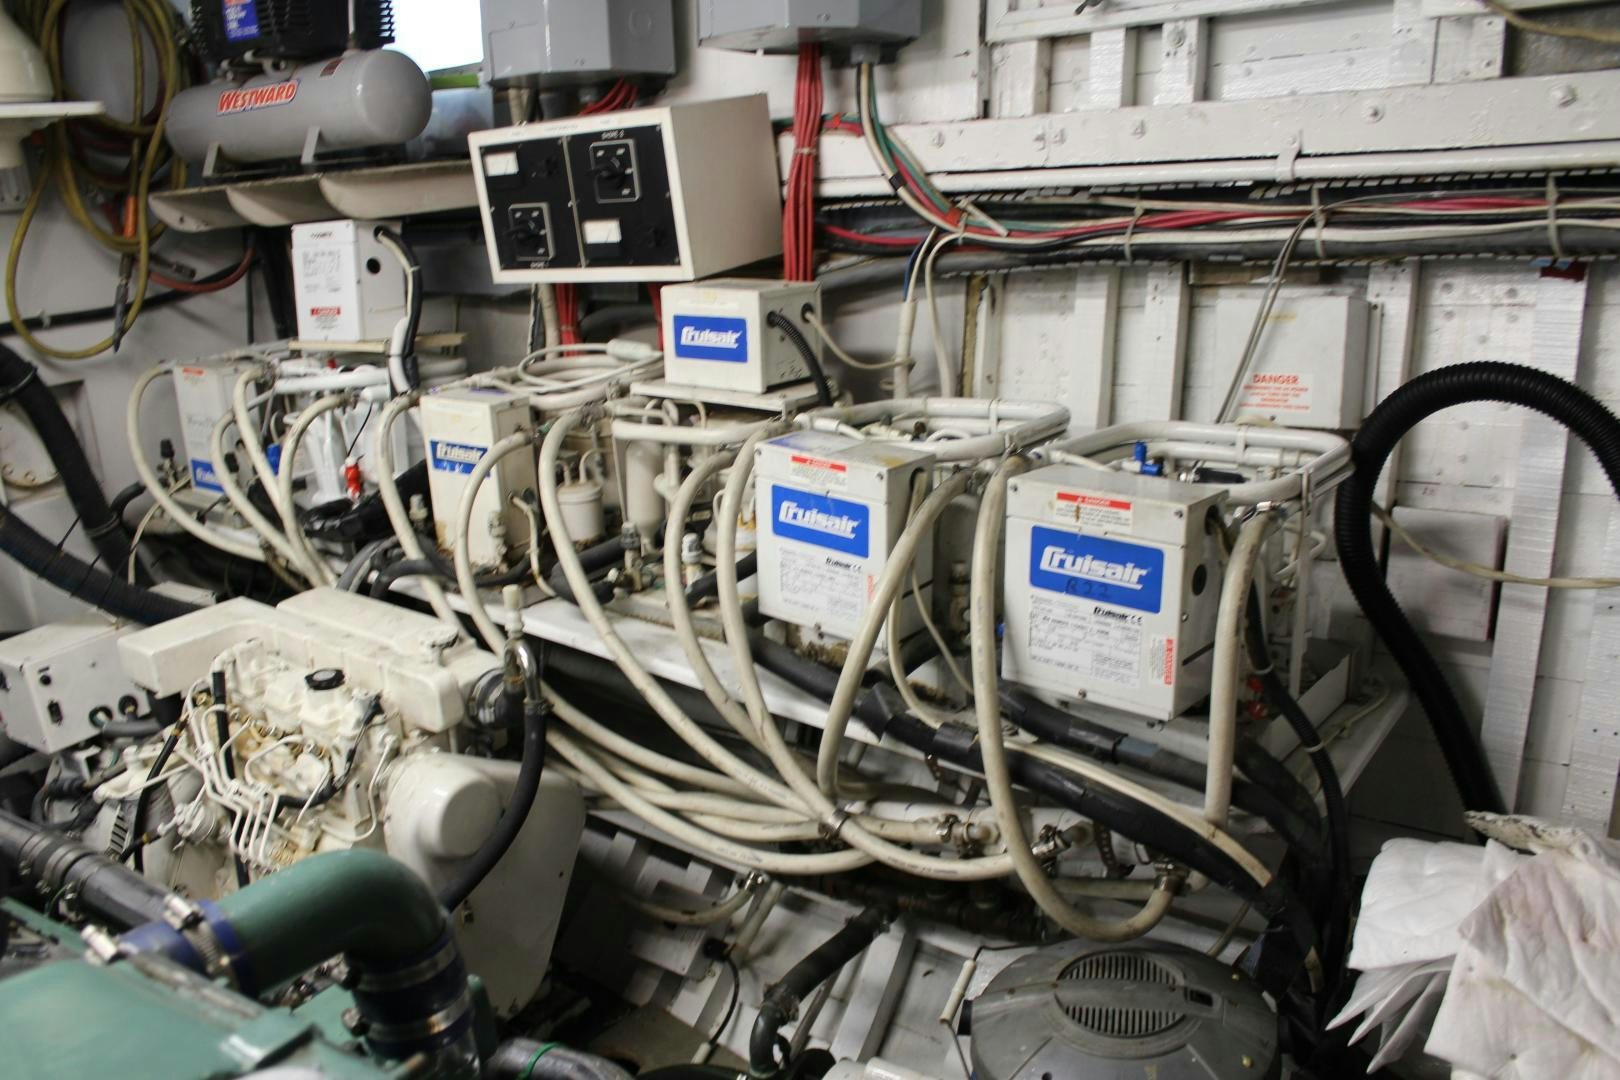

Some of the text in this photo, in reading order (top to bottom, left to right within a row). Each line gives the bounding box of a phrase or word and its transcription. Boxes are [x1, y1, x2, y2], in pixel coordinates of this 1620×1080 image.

[219, 82, 297, 112] WESTWARD
[680, 325, 743, 349] Cruisair
[1252, 373, 1299, 385] DANGER
[778, 499, 861, 540] Cruisair
[1039, 545, 1150, 590] Cruisair
